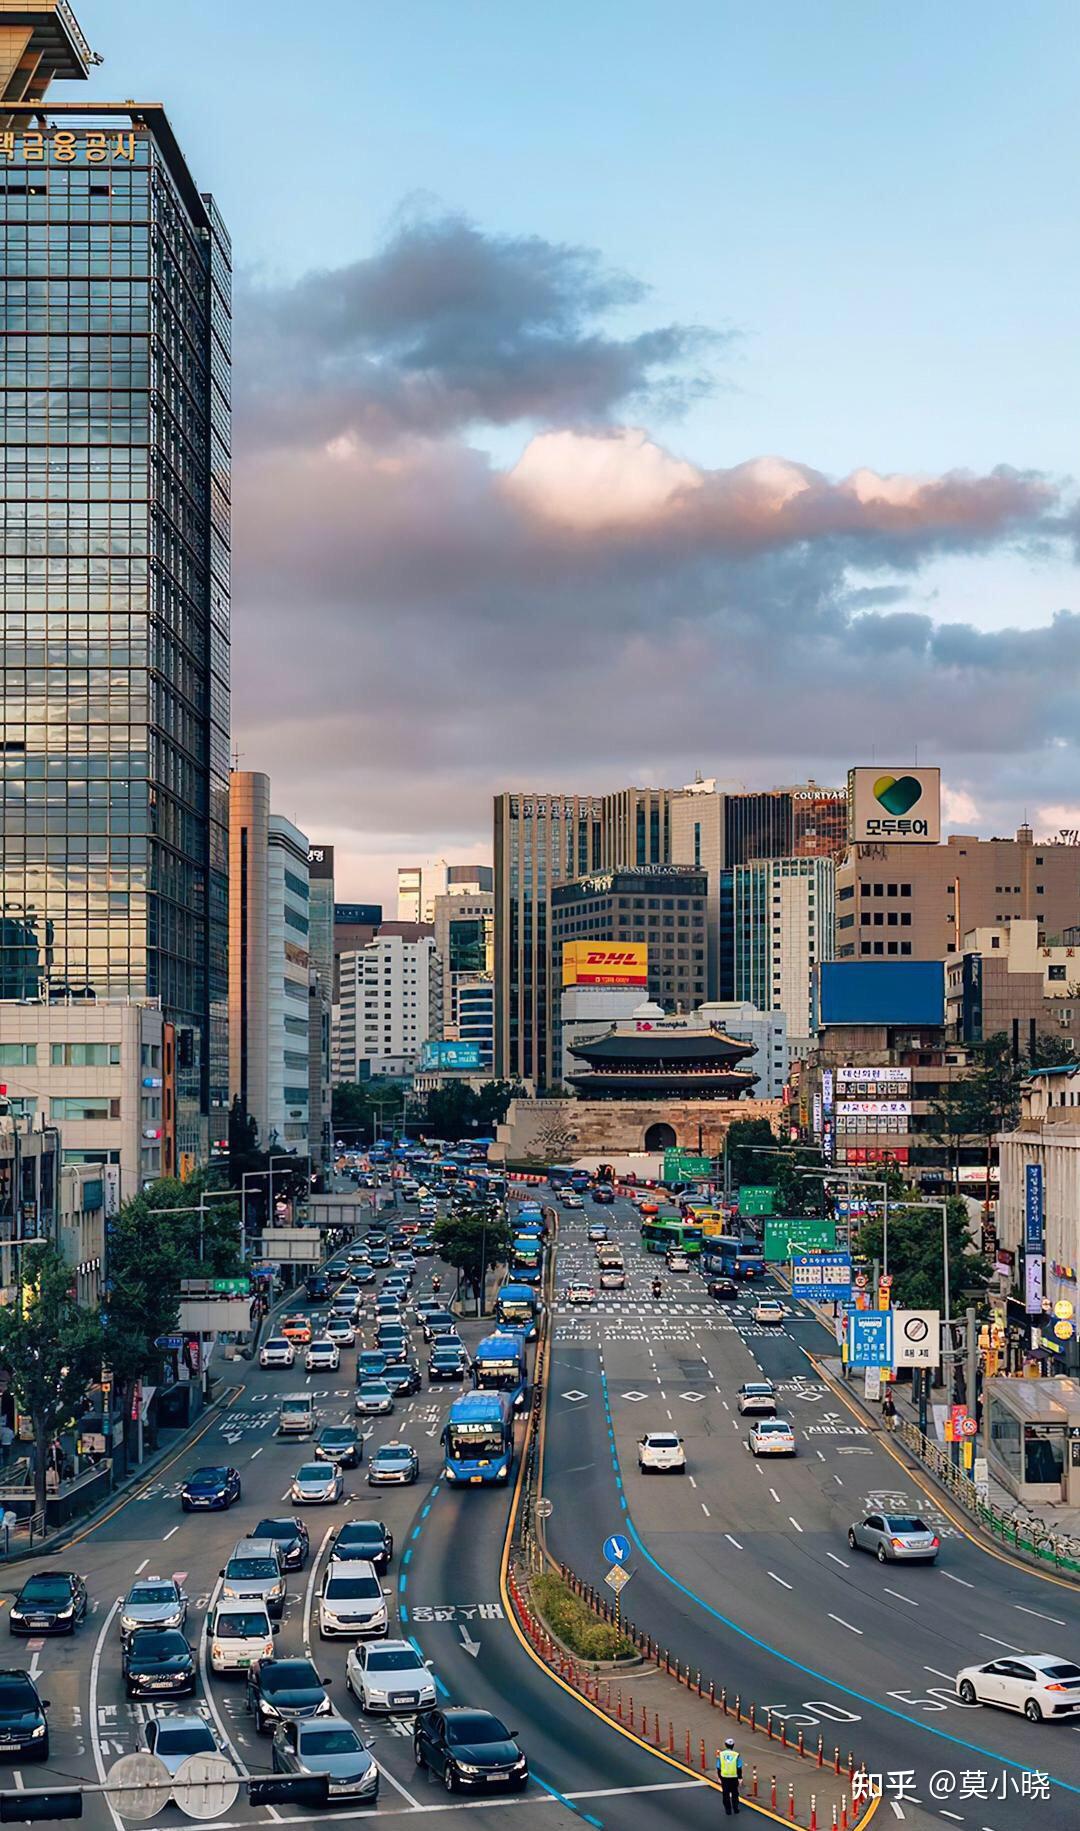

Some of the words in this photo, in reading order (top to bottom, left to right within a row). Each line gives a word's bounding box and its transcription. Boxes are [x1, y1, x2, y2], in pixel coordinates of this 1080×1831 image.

[794, 790, 849, 800] COURTYAR
[866, 819, 929, 836] 모두투어
[586, 951, 638, 966] DHL
[886, 1687, 984, 1711] 50
[760, 1701, 862, 1726] 50
